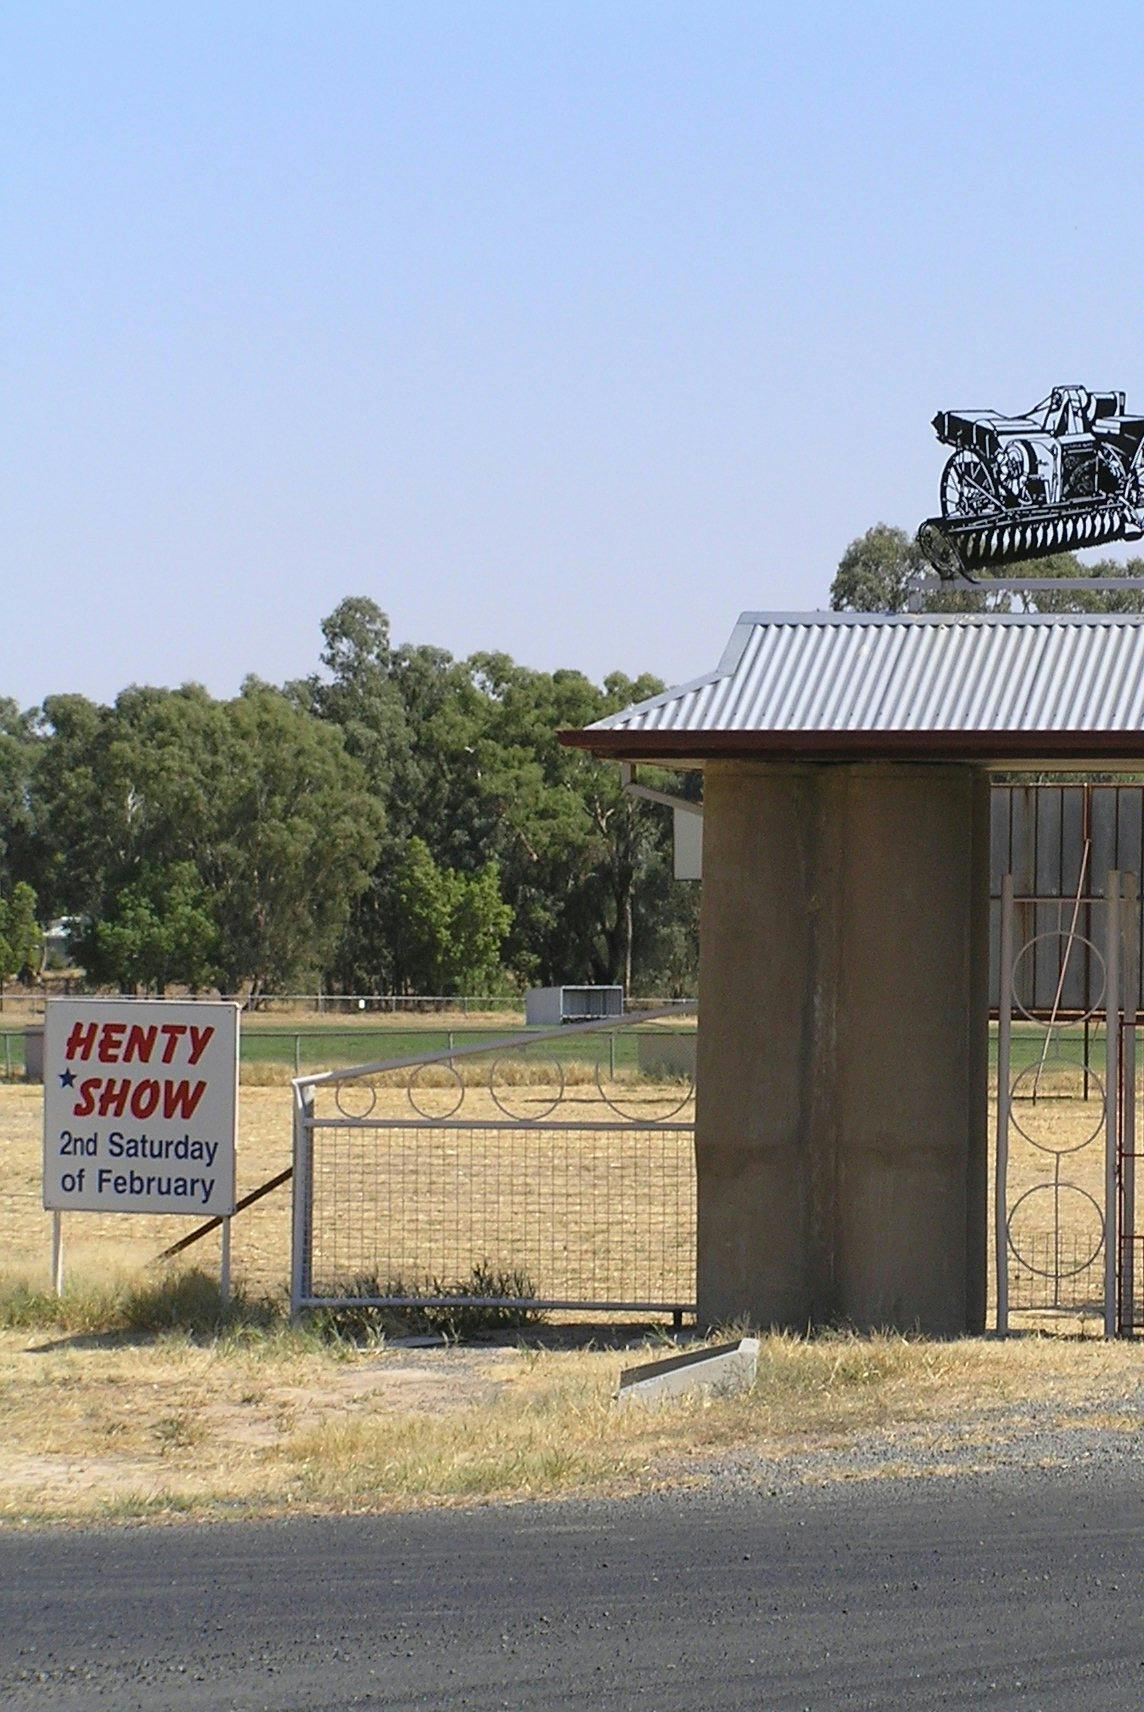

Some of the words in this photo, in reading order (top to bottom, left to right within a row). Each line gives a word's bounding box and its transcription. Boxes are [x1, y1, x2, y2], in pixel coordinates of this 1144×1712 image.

[65, 1022, 215, 1065] HENTY
[73, 1077, 207, 1120] SHOW
[60, 1130, 98, 1156] 2nd
[108, 1132, 219, 1167] Saturday
[61, 1168, 85, 1193] of
[97, 1169, 215, 1204] February
